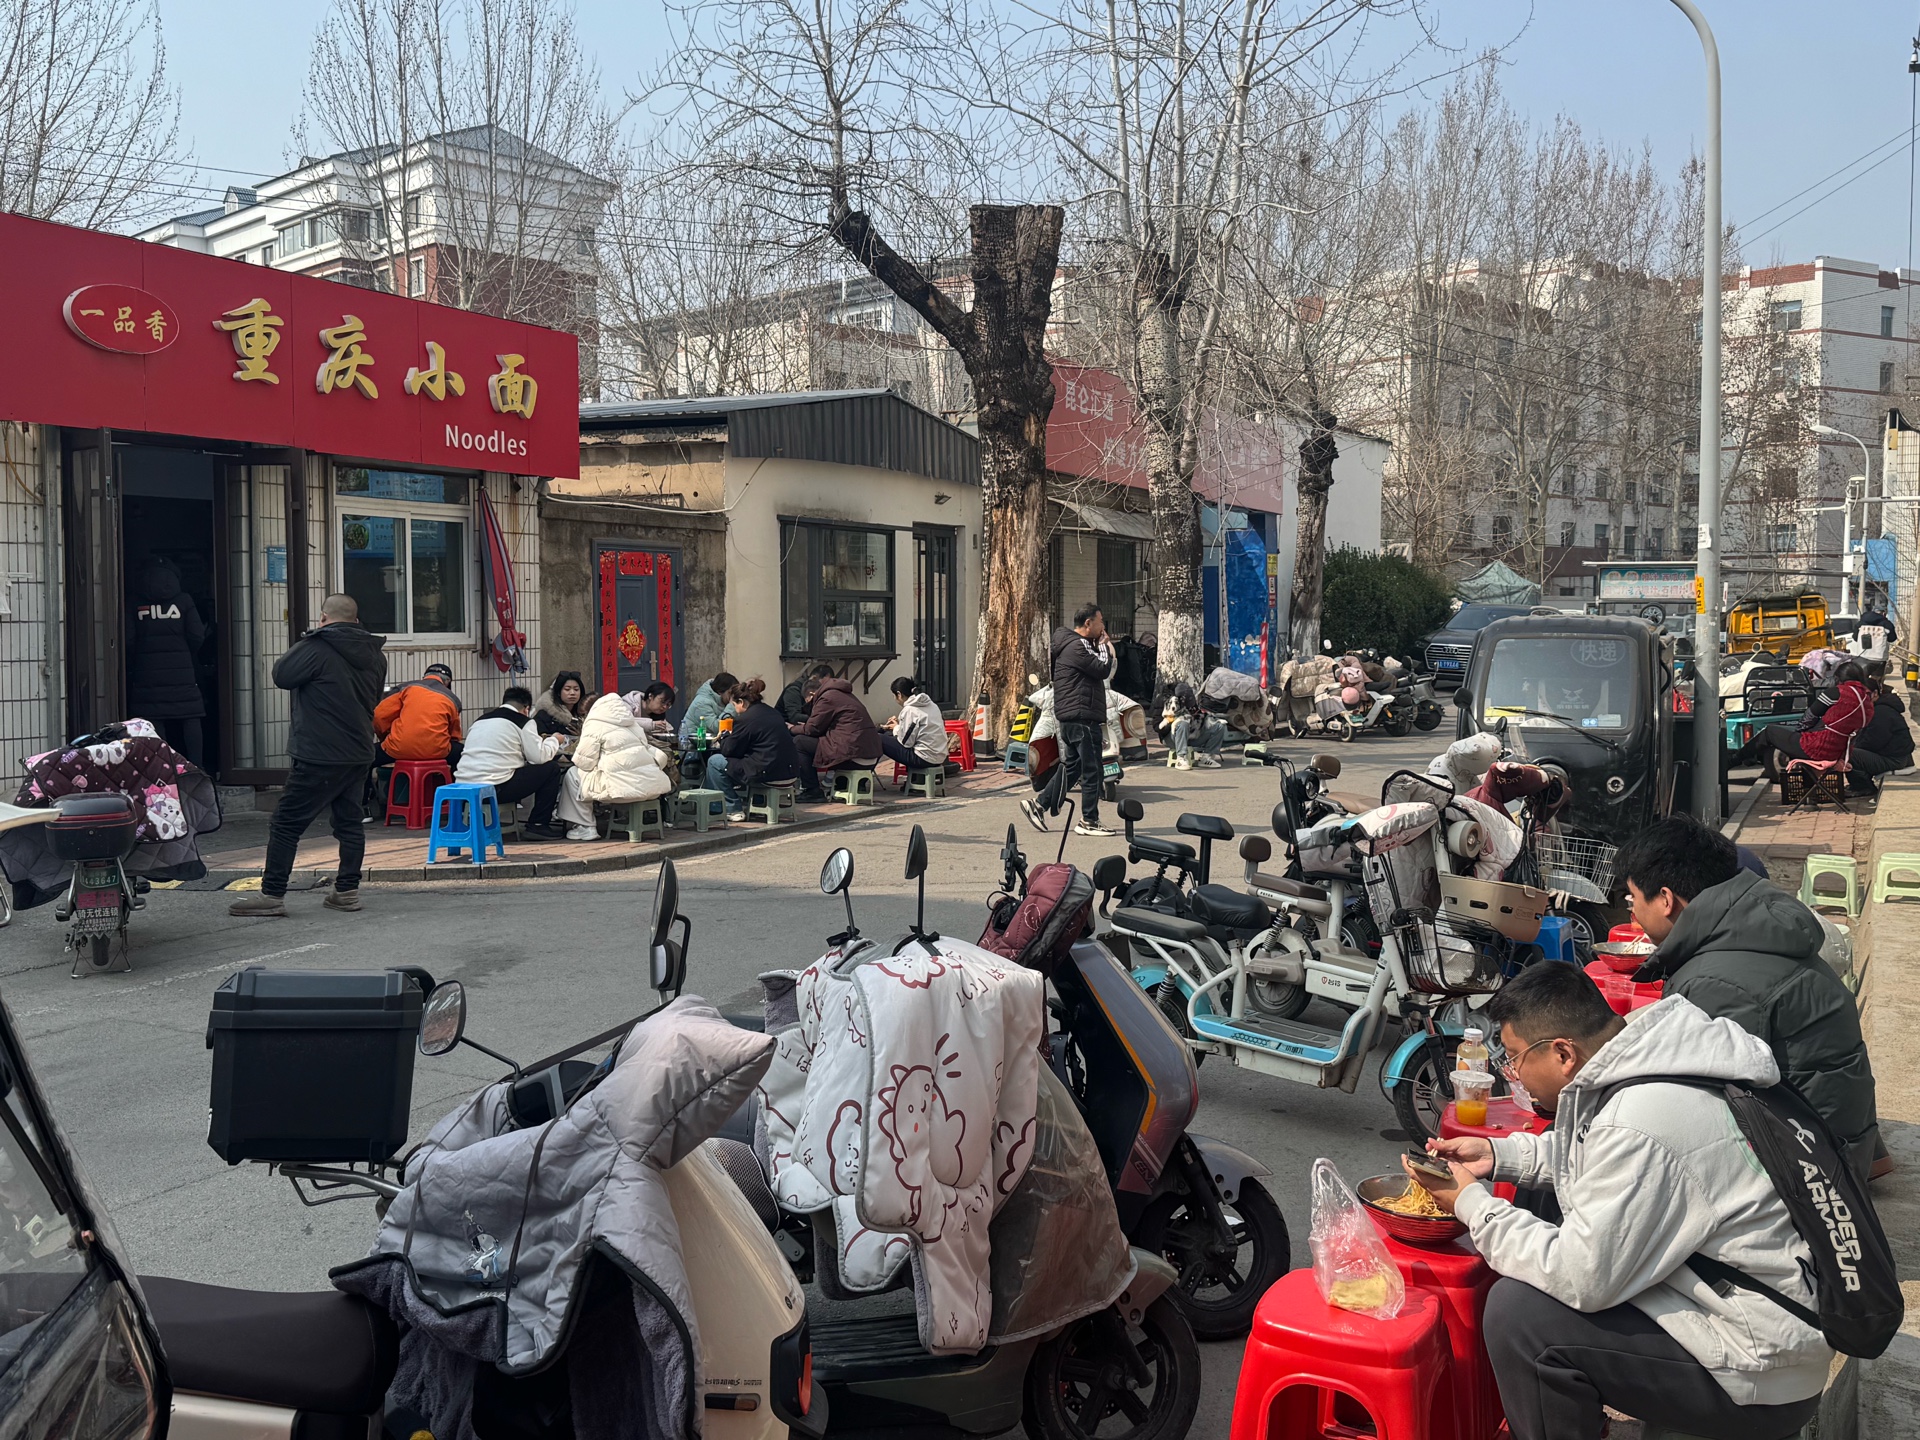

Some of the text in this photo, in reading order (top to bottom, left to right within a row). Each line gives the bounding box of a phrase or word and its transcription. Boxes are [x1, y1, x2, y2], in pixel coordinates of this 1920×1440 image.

[80, 305, 168, 343] 一品香
[212, 297, 539, 420] 重庆小面
[1065, 380, 1114, 422] 昆仑汇通
[445, 423, 528, 457] Noodles
[137, 604, 181, 620] FILA
[625, 624, 641, 648] 福
[1578, 640, 1617, 662] 快递
[1797, 1159, 1861, 1293] ARMOUR
[1817, 1165, 1863, 1261] NDER
